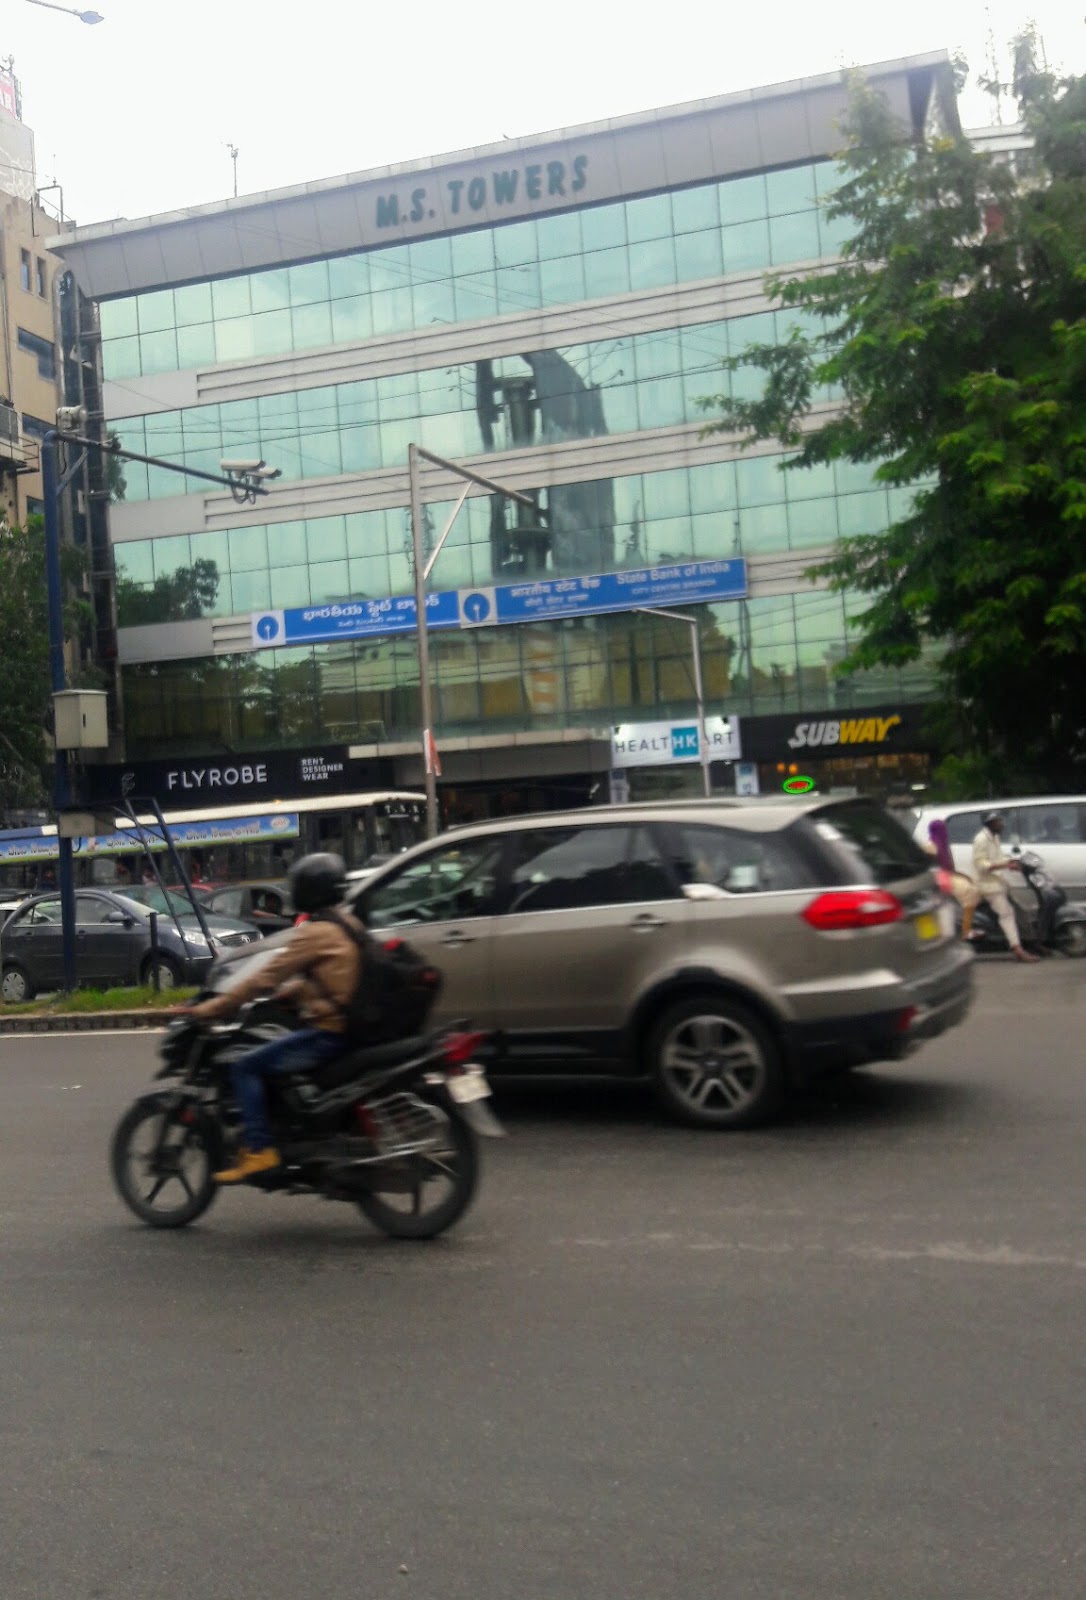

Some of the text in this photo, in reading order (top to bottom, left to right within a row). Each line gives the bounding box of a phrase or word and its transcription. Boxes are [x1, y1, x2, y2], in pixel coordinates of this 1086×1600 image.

[376, 154, 588, 228] M.S. TOWERS
[617, 561, 730, 585] State Bank of India
[788, 714, 900, 748] SUBWAY
[301, 757, 324, 766] RENT
[302, 763, 344, 774] DESIGNER
[168, 765, 267, 790] FLYROBE
[303, 773, 329, 781] WEAR
